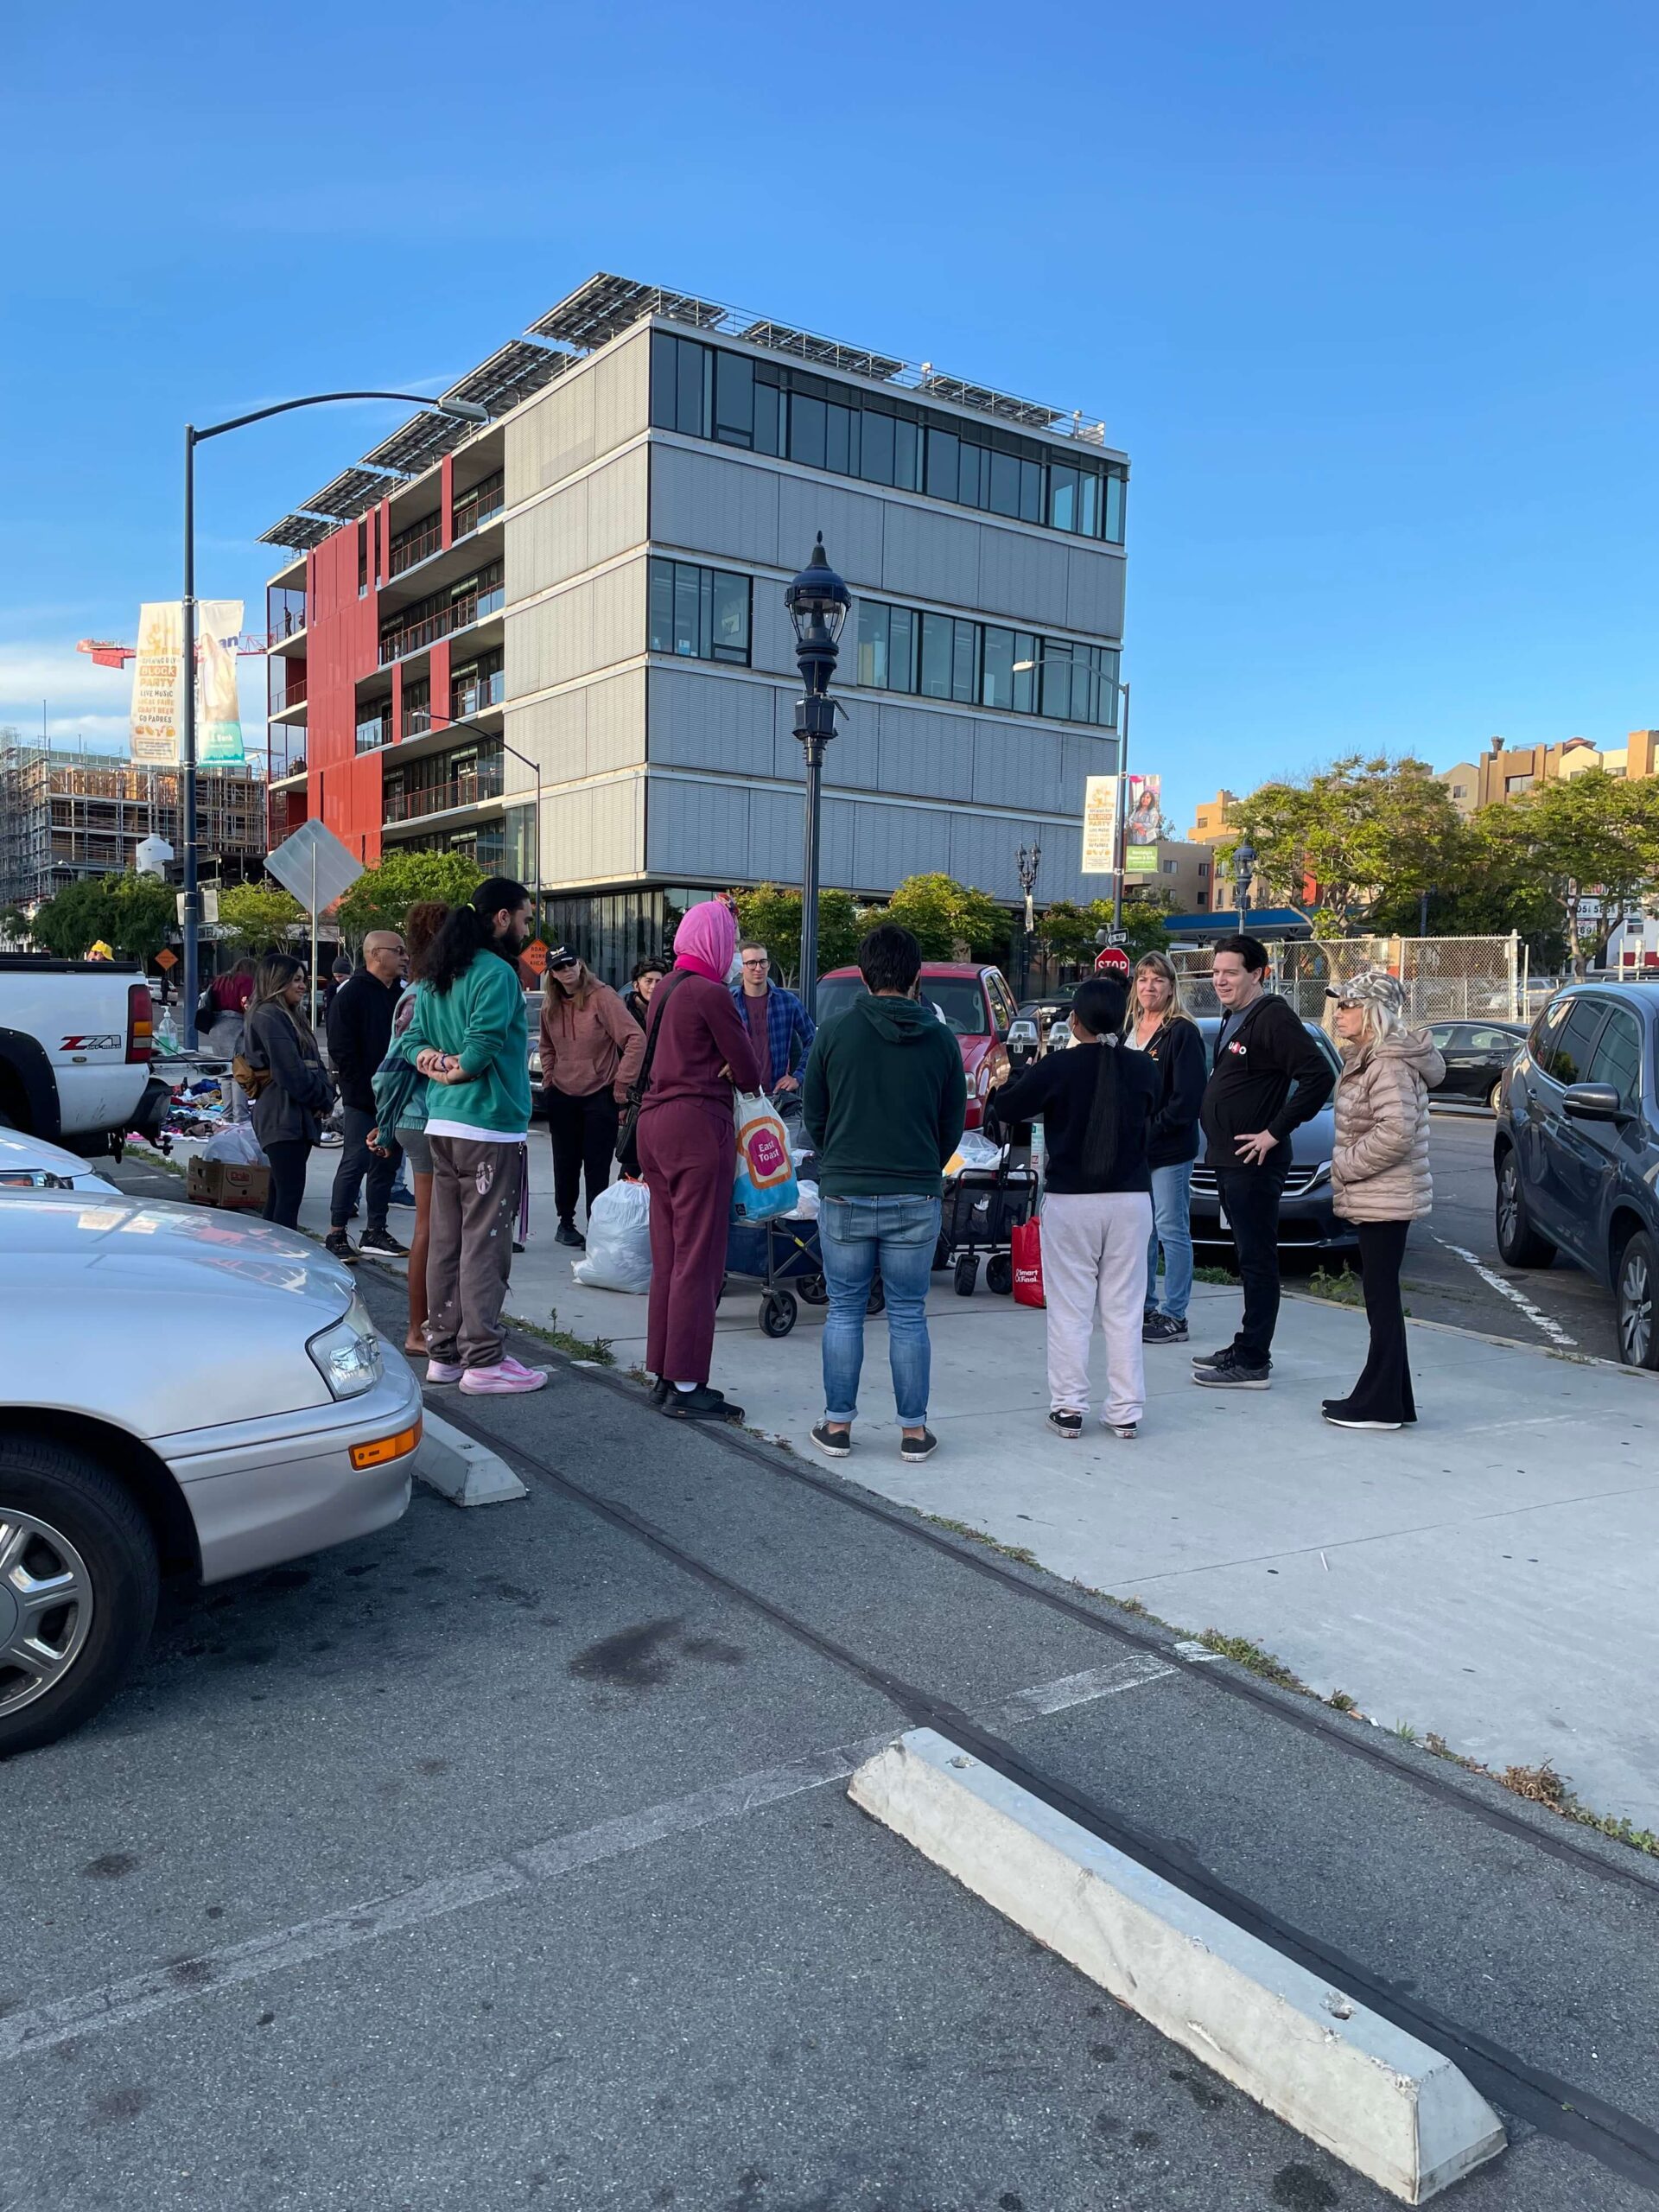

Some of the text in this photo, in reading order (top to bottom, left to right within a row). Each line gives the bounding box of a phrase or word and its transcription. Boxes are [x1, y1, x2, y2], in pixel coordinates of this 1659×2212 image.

[141, 666, 175, 677] BLOCK
[140, 678, 175, 688] PARTY
[148, 715, 172, 724] PADRES
[1097, 961, 1127, 969] STOP
[58, 1035, 122, 1051] Z71
[758, 1140, 775, 1153] East
[758, 1148, 779, 1163] Toast
